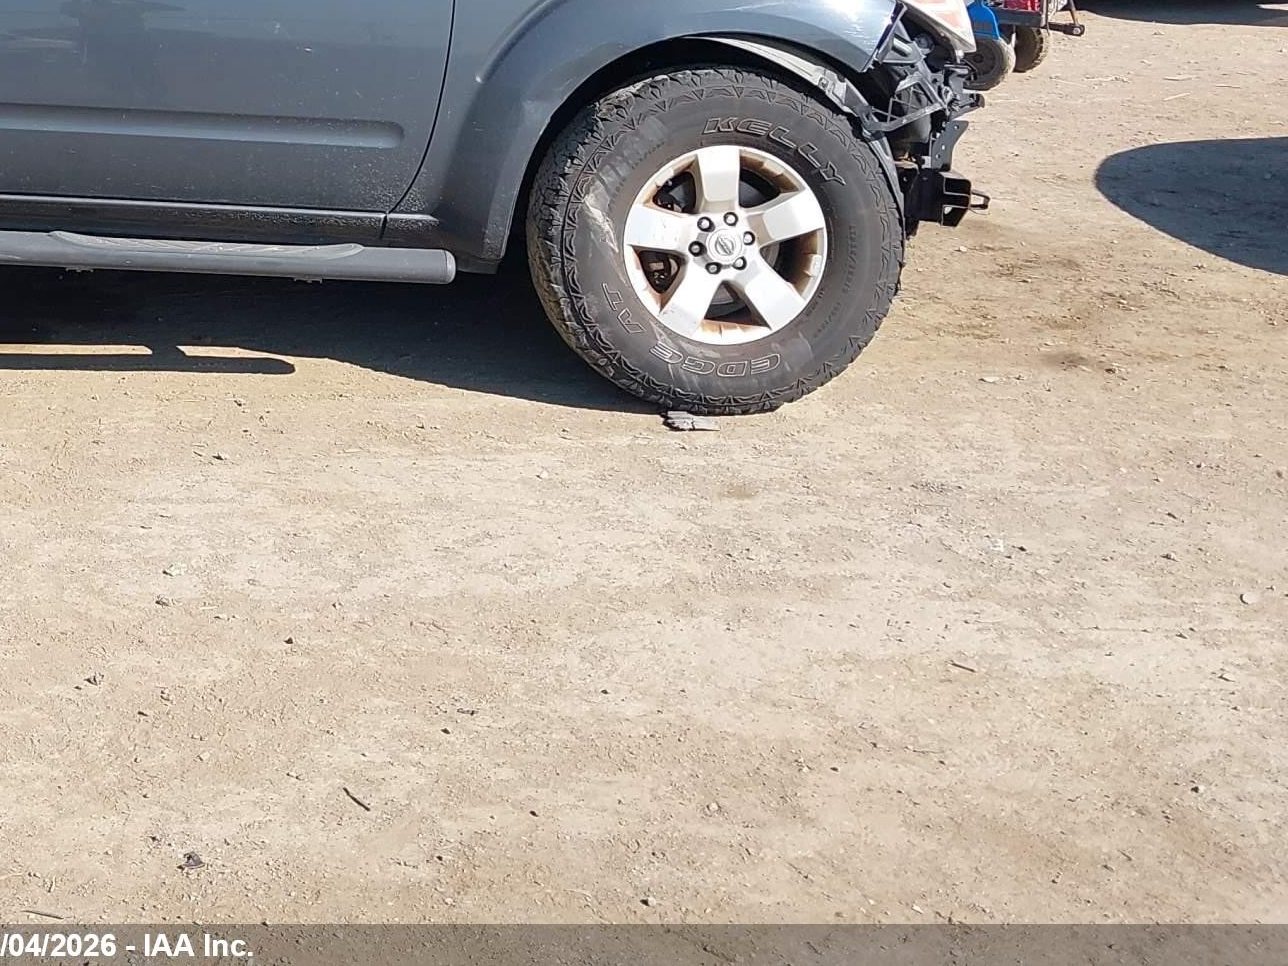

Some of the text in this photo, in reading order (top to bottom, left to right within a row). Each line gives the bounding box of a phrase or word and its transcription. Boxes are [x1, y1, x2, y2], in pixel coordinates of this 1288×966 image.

[703, 117, 846, 185] KELLY
[601, 282, 782, 377] EDGE AT
